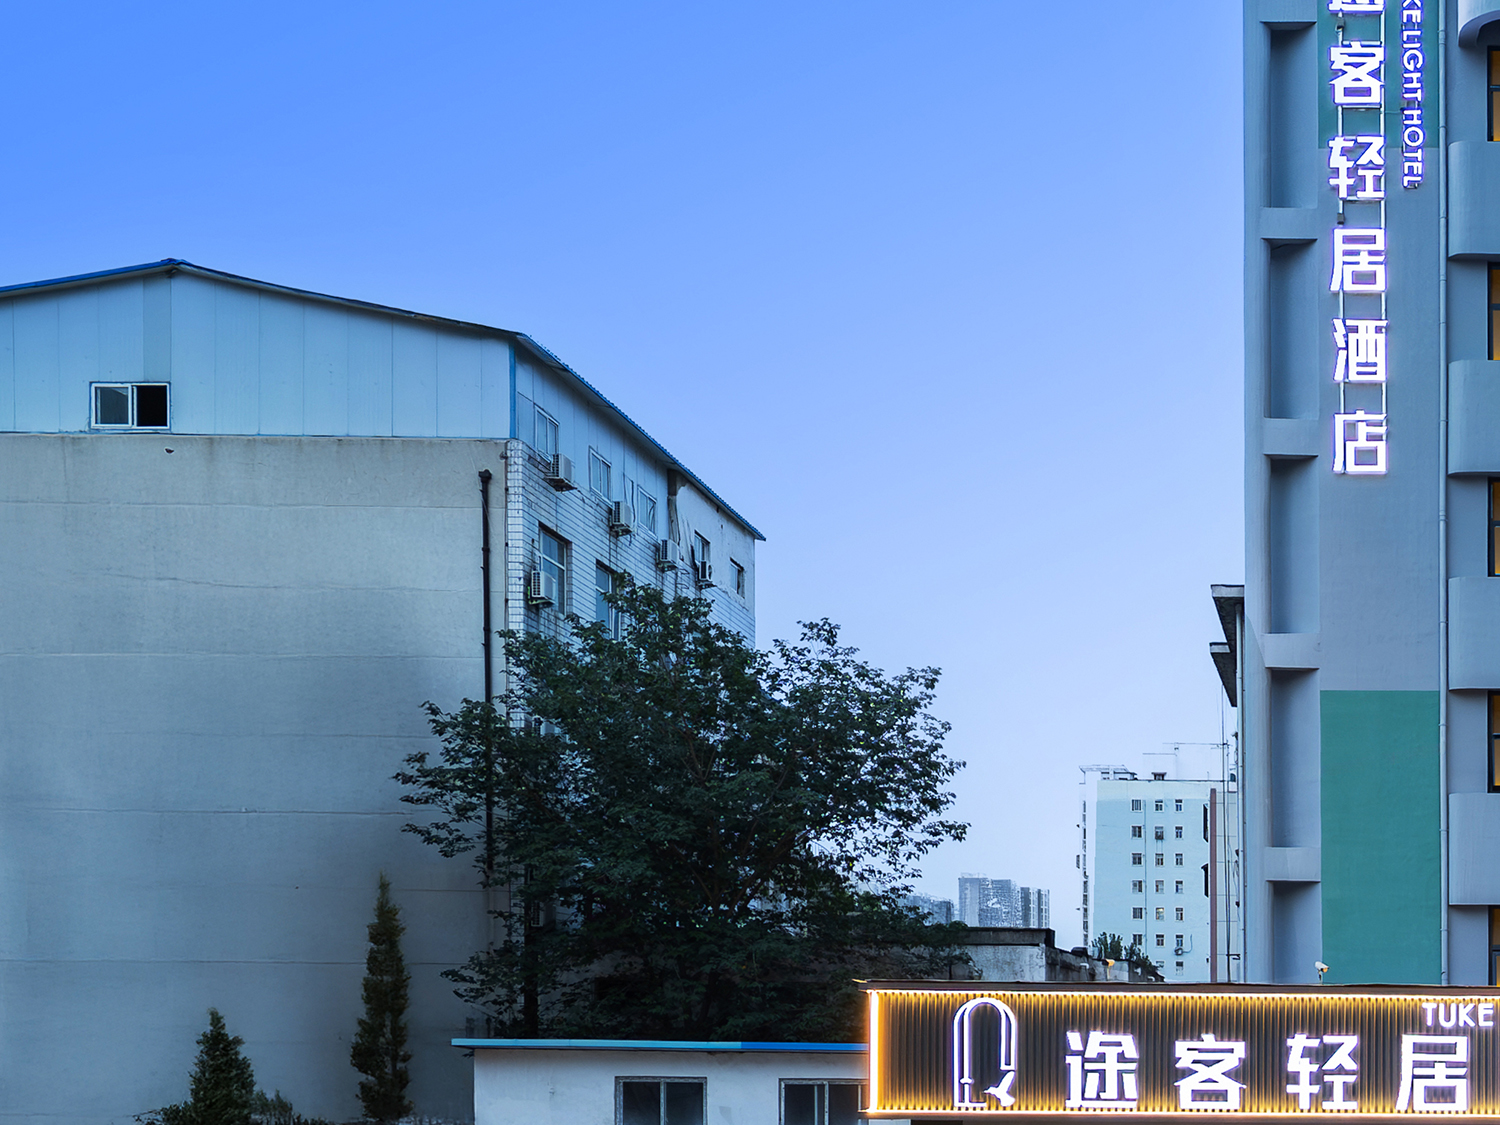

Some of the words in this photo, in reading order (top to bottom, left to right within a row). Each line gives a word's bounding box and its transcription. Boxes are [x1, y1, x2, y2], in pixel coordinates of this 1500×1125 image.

[1401, 30, 1425, 102] LIGHT
[1401, 109, 1425, 189] HOTEL
[1327, 0, 1388, 475] 客轻居酒店
[1421, 1002, 1495, 1028] TUKE
